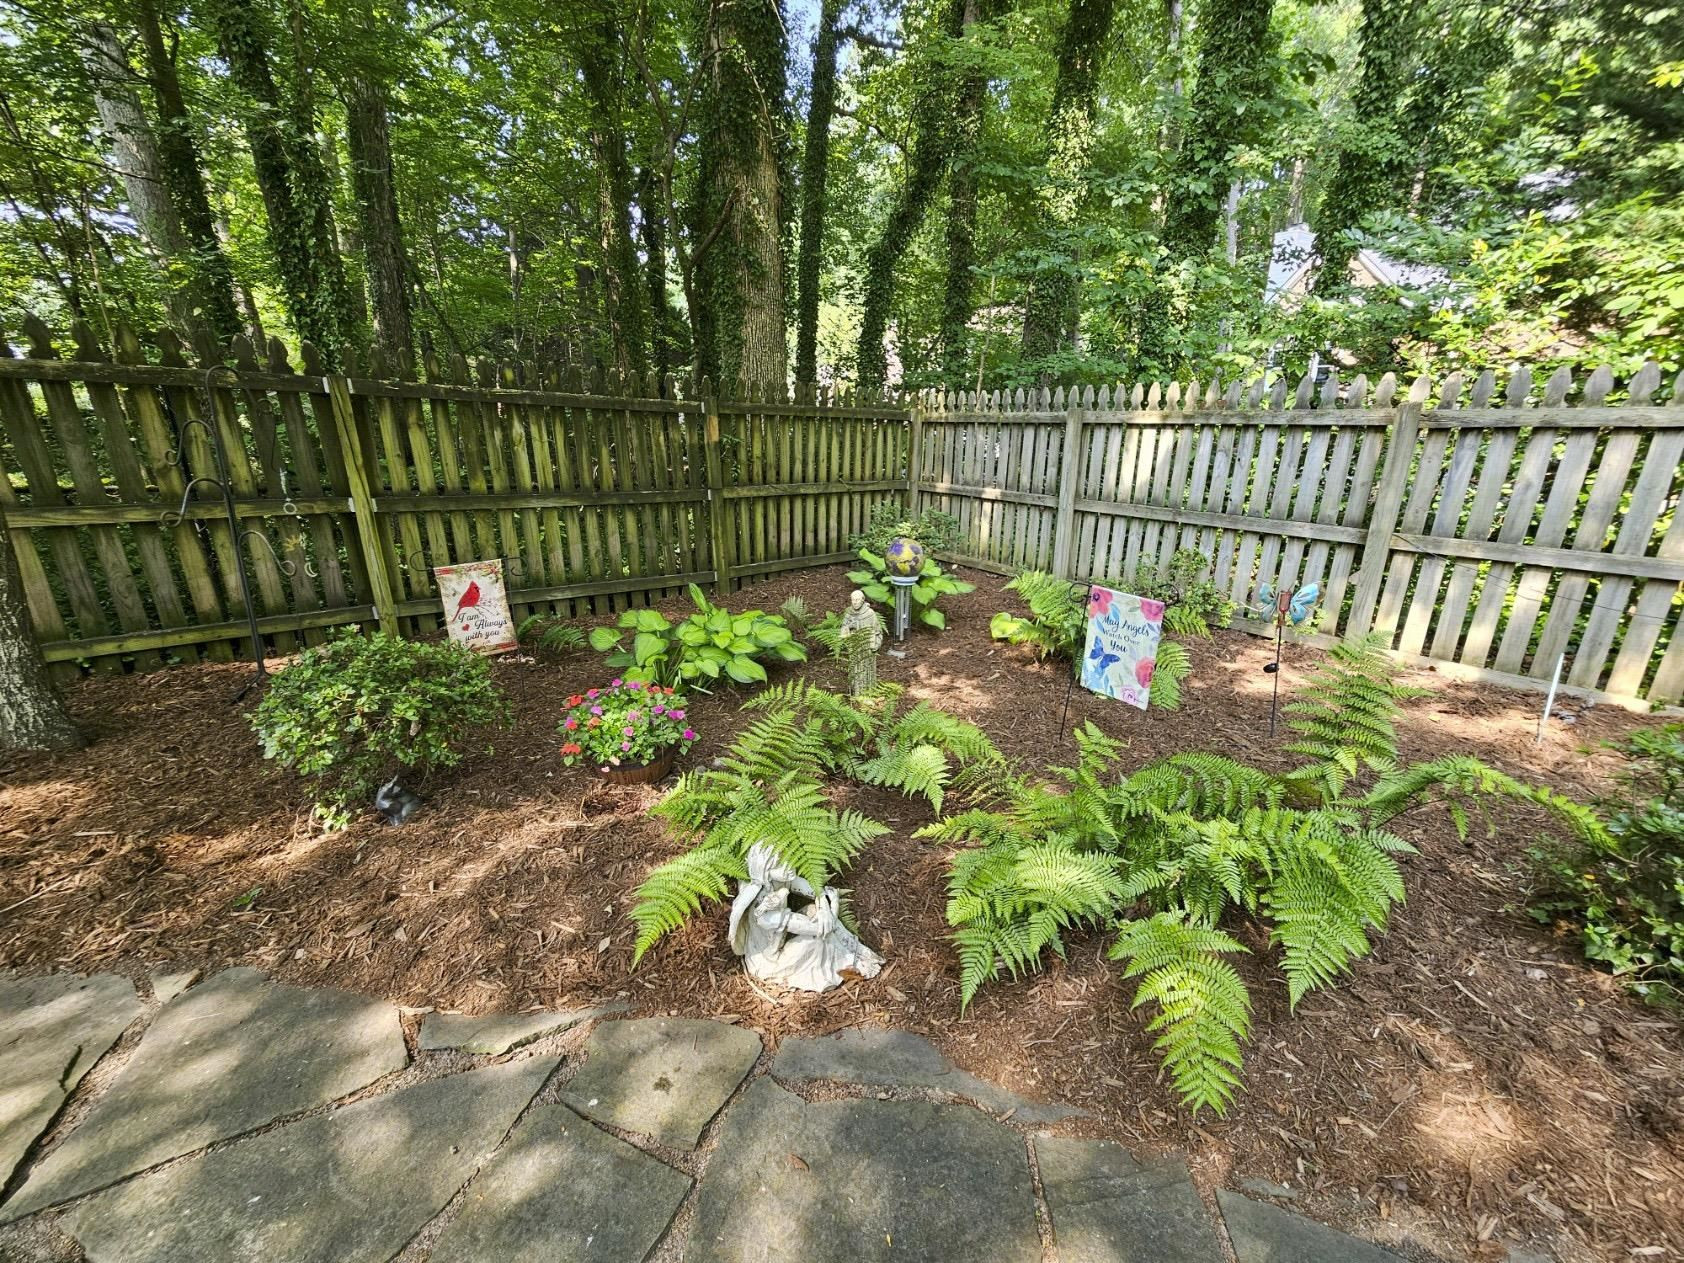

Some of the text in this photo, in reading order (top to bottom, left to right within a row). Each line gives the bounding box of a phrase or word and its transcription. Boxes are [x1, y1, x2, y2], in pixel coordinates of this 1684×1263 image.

[458, 613, 466, 623] I
[474, 619, 507, 629] Always
[1103, 615, 1150, 637] May Angels
[465, 630, 500, 641] with you
[1102, 628, 1123, 640] Watch
[1110, 640, 1127, 653] You
